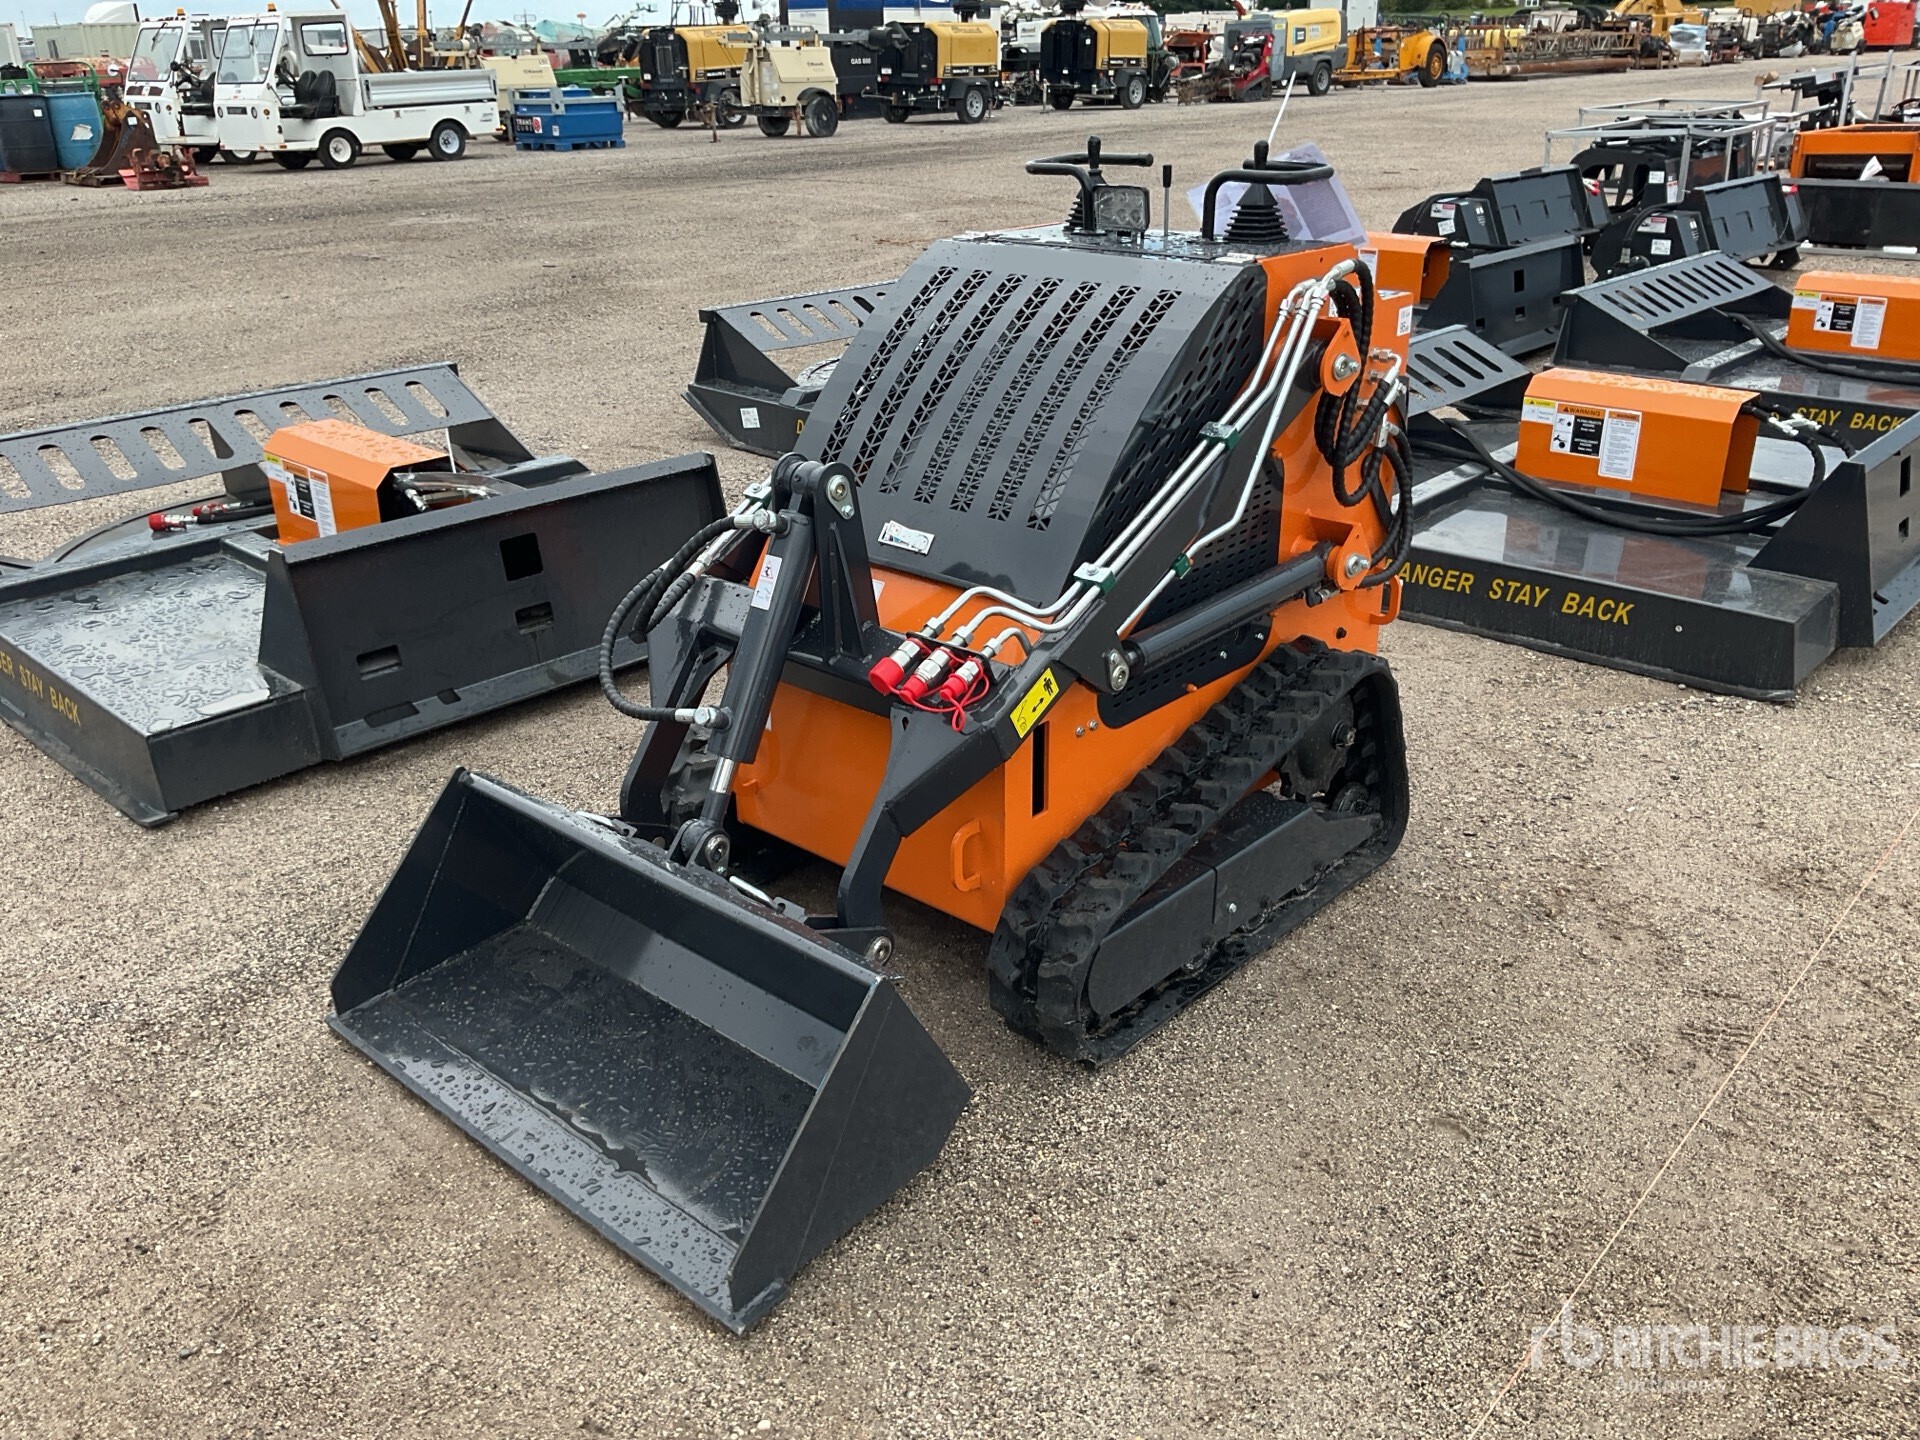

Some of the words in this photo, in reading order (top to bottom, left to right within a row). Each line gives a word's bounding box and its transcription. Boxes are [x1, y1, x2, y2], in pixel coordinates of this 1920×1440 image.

[1569, 407, 1601, 417] WARNING
[1388, 560, 1475, 595] ANGER
[1488, 578, 1550, 608] STAY
[1560, 591, 1635, 626] BACK
[19, 664, 43, 699] STAY
[49, 686, 81, 726] BACK
